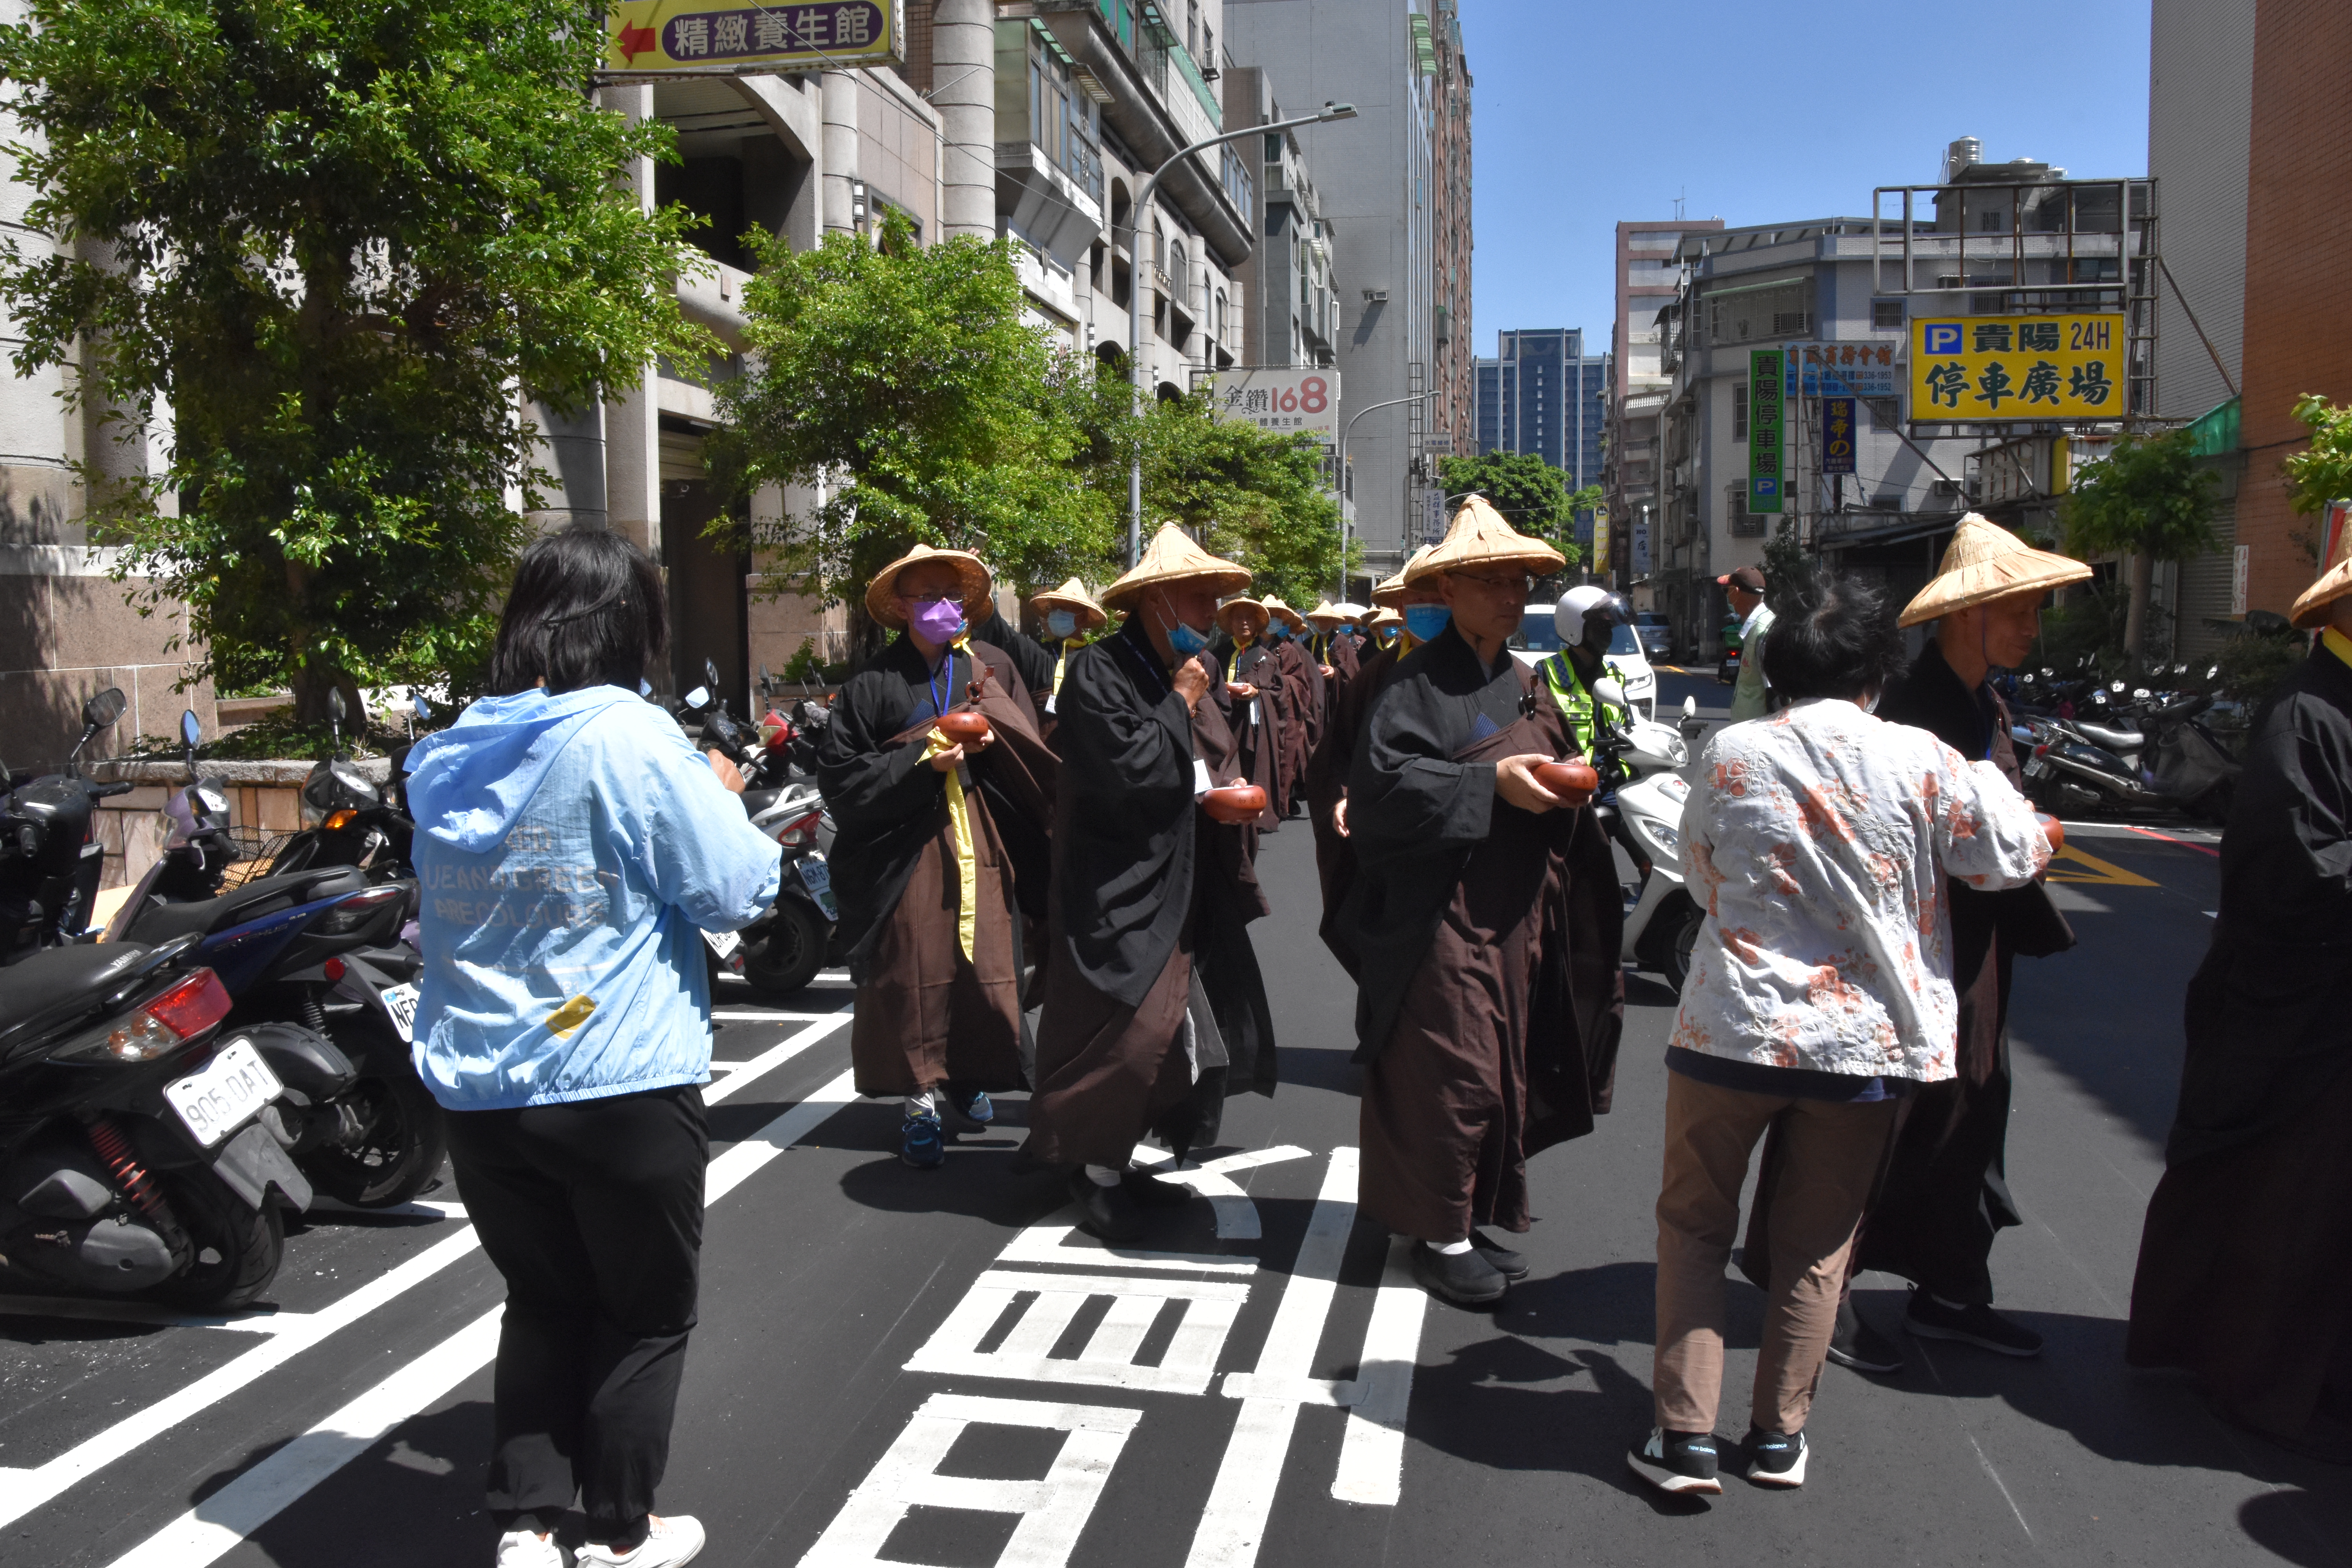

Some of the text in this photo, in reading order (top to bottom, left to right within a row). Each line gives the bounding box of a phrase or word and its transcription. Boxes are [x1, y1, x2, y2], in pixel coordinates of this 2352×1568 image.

[674, 5, 870, 57] 精緻養生館
[1932, 328, 1957, 350] P
[1972, 323, 2060, 353] 貴陽
[2070, 321, 2109, 350] 24H
[1925, 360, 2112, 410] 停車廣場
[1755, 355, 1779, 474] 貴陽停車場
[1758, 481, 1773, 492] P
[110, 949, 143, 968] YAMAHA
[185, 1059, 269, 1133] 905-DAT
